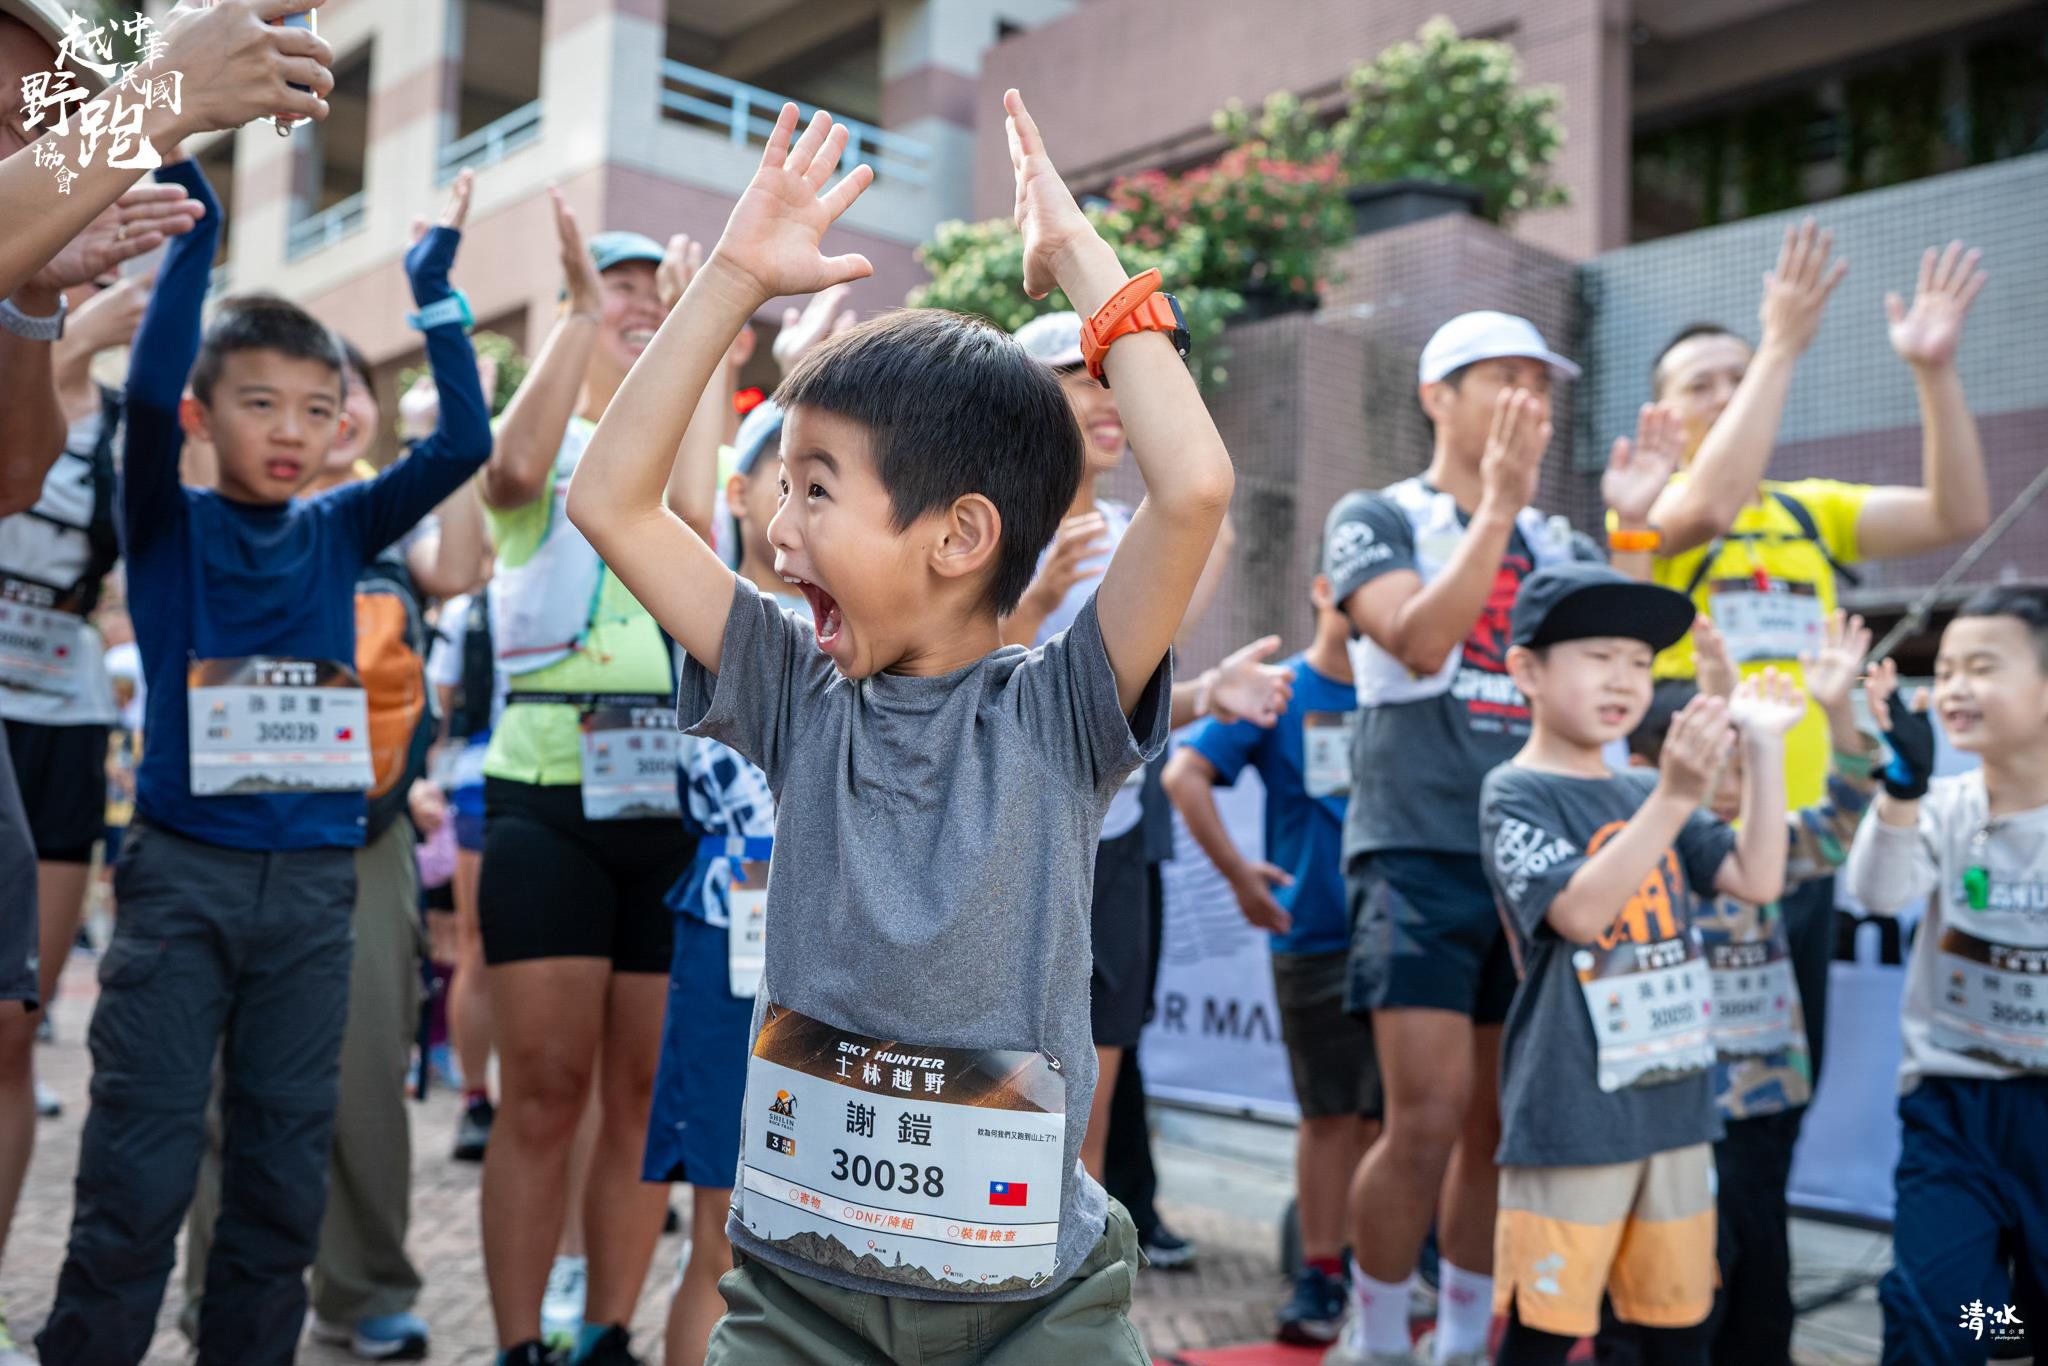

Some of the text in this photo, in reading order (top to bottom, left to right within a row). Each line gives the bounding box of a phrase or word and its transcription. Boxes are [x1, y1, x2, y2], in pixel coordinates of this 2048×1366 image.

[1202, 995, 1277, 1043] MA
[838, 1041, 945, 1069] SKY HUNTER
[836, 1056, 945, 1094] 士林越野
[769, 1113, 794, 1126] SHILIN
[772, 1136, 779, 1148] 3
[782, 1145, 792, 1154] KM
[831, 1148, 945, 1198] 30038
[961, 1227, 1017, 1242] 裝備檢查
